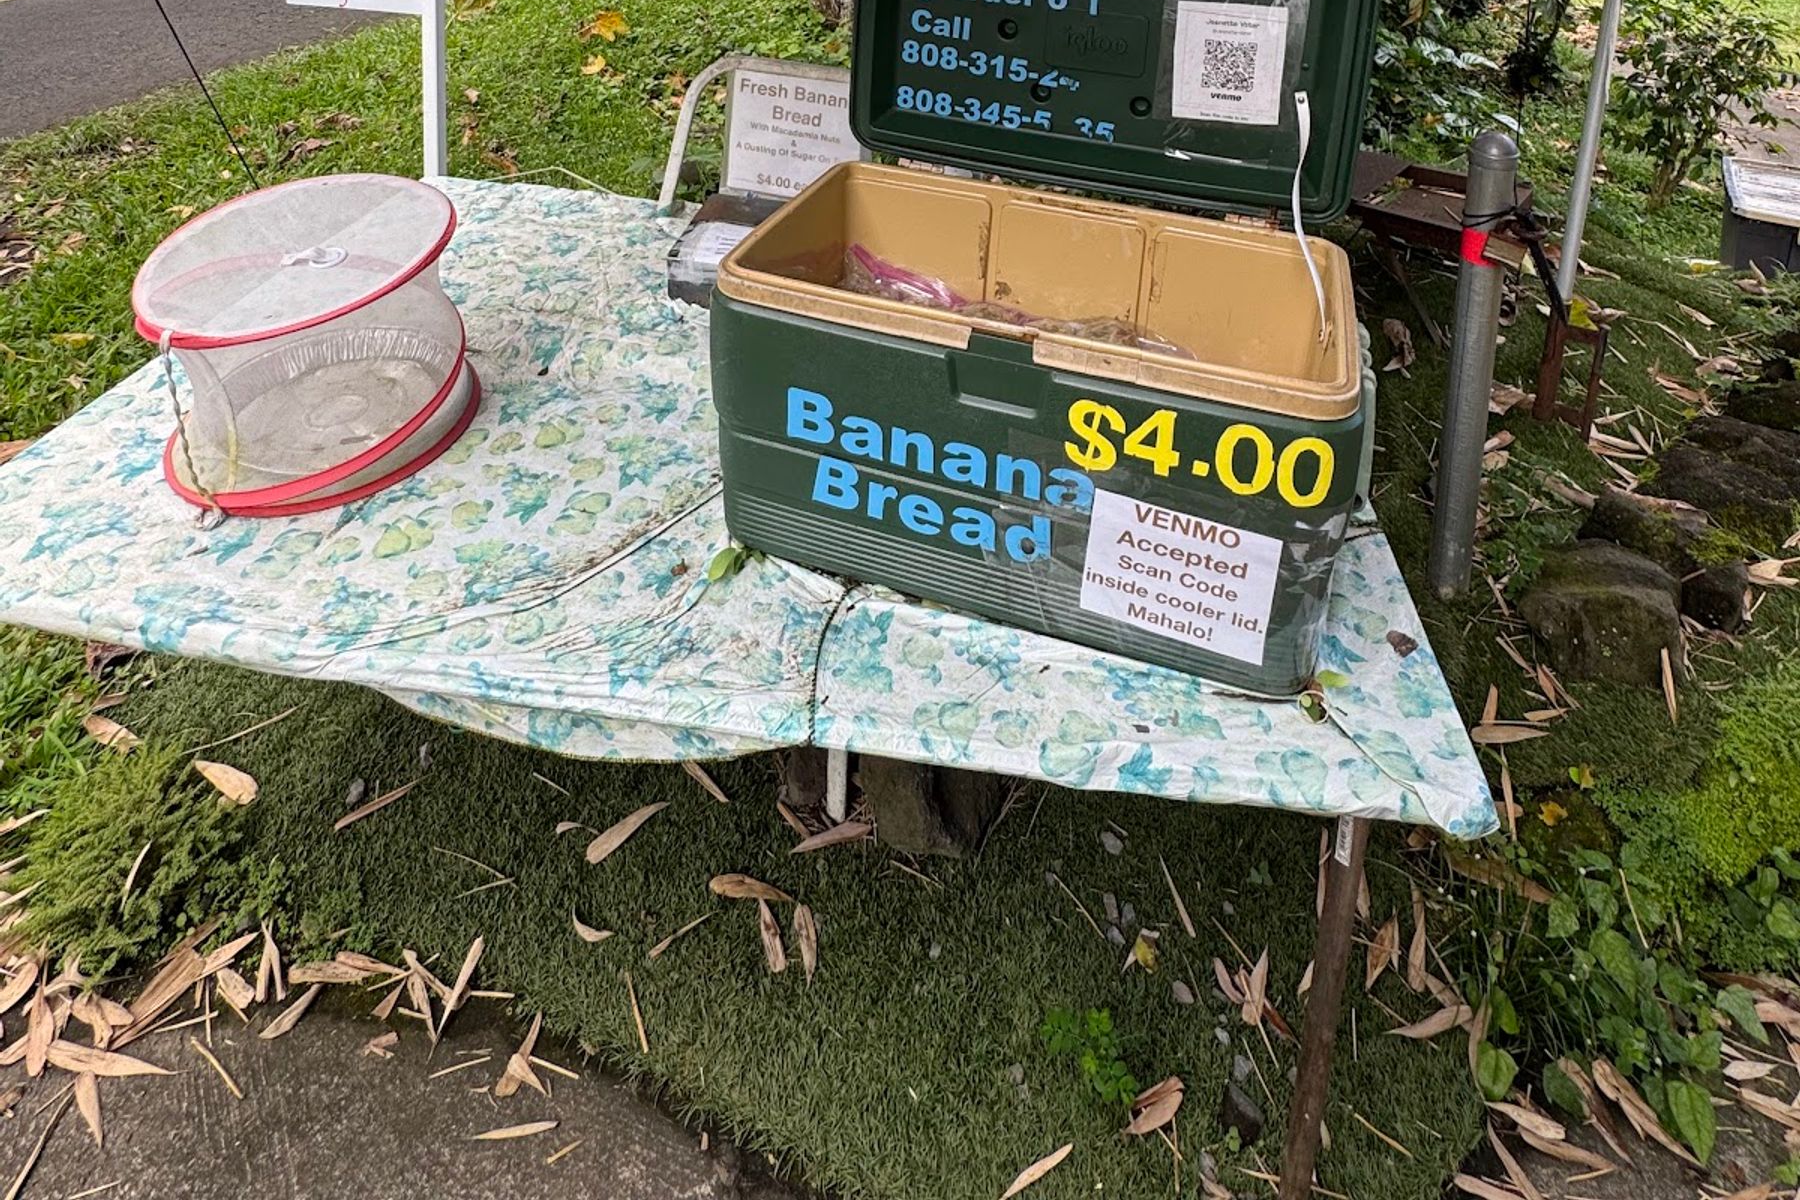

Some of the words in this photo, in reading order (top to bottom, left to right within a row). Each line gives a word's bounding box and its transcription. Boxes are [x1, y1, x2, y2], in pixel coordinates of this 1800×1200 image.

[911, 9, 972, 41] Call
[740, 78, 789, 99] Fresh
[794, 85, 849, 109] Banan
[772, 105, 822, 127] Bread
[736, 141, 742, 149] A
[744, 142, 777, 156] Dusting
[778, 148, 789, 157] Of
[791, 150, 817, 161] Sugar
[750, 121, 769, 132] With
[771, 124, 819, 140] Macadamia
[820, 134, 840, 144] Nuts
[786, 386, 1095, 515] Banana
[1064, 399, 1335, 508] $4.00
[812, 456, 1052, 563] Bread
[1135, 503, 1241, 549] VENMO
[1116, 530, 1248, 579] Accepted
[1086, 567, 1149, 598] inside
[1155, 591, 1225, 621] cooler
[1232, 612, 1263, 634] lid.
[1118, 554, 1172, 582] Scan
[1179, 572, 1238, 602] Code
[1127, 603, 1213, 641] Mahalo!
